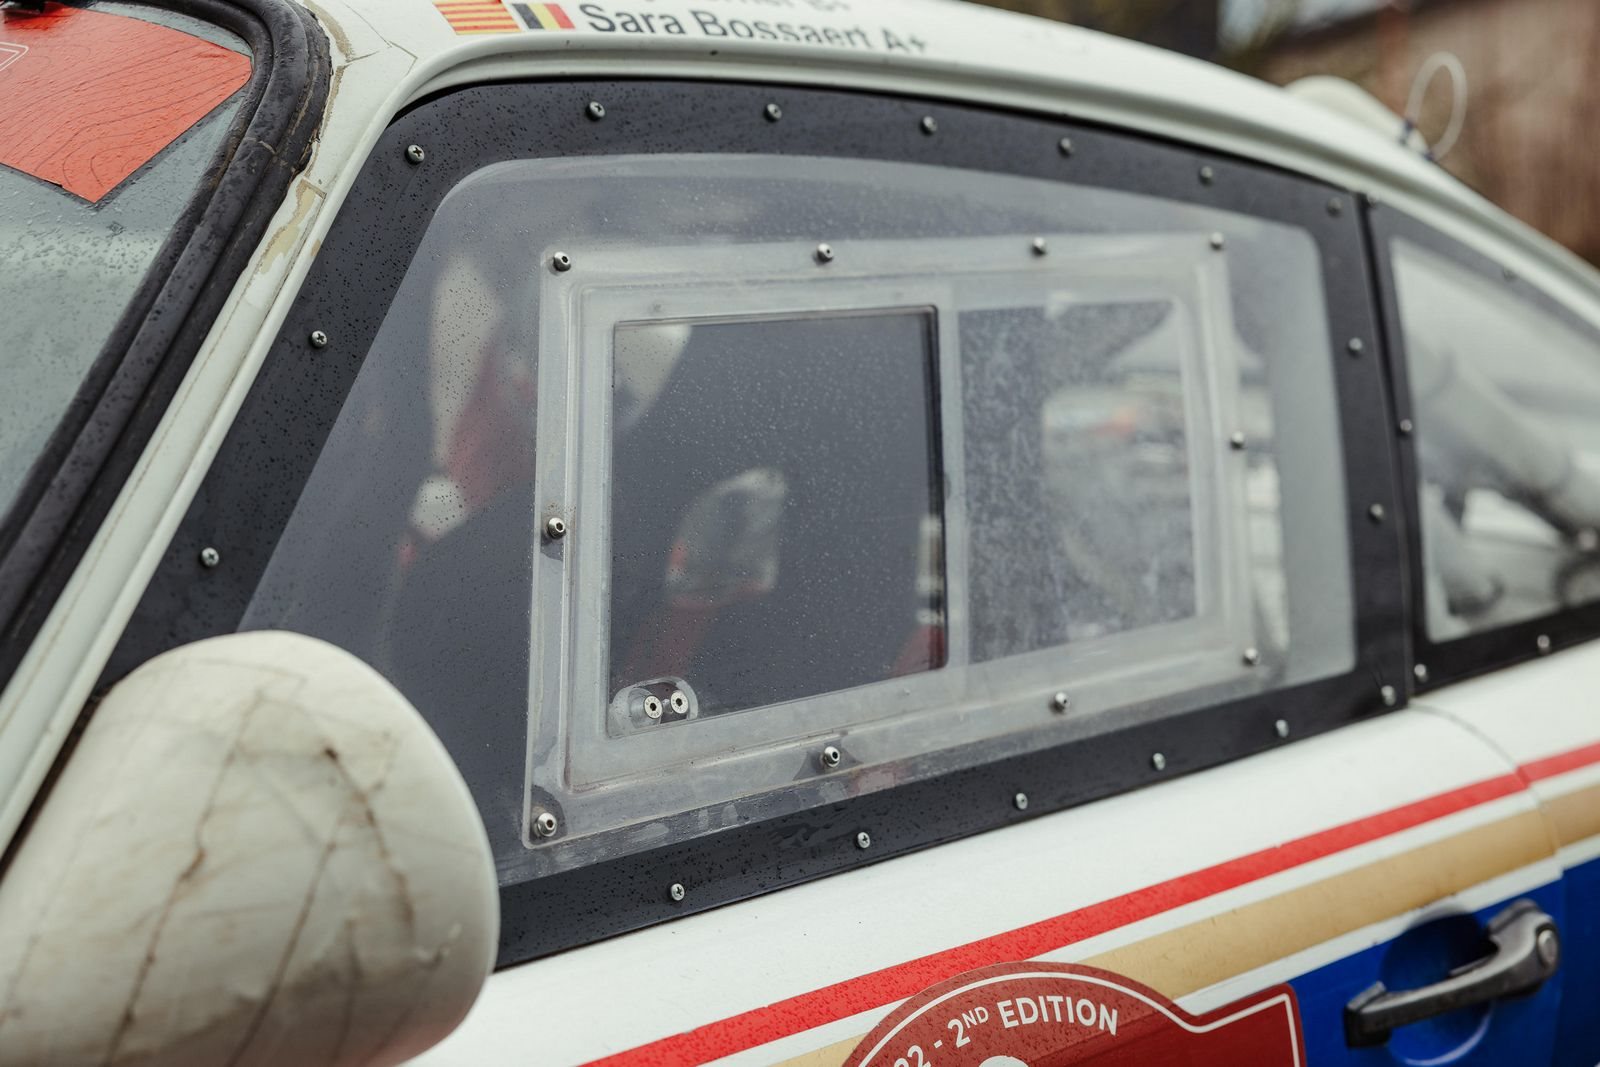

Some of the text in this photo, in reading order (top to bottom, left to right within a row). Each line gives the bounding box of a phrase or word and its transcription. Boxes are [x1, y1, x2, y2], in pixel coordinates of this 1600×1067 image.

[579, 4, 926, 52] Sara Bossaert A+
[947, 1006, 989, 1047] 2ND
[997, 995, 1118, 1036] EDITION
